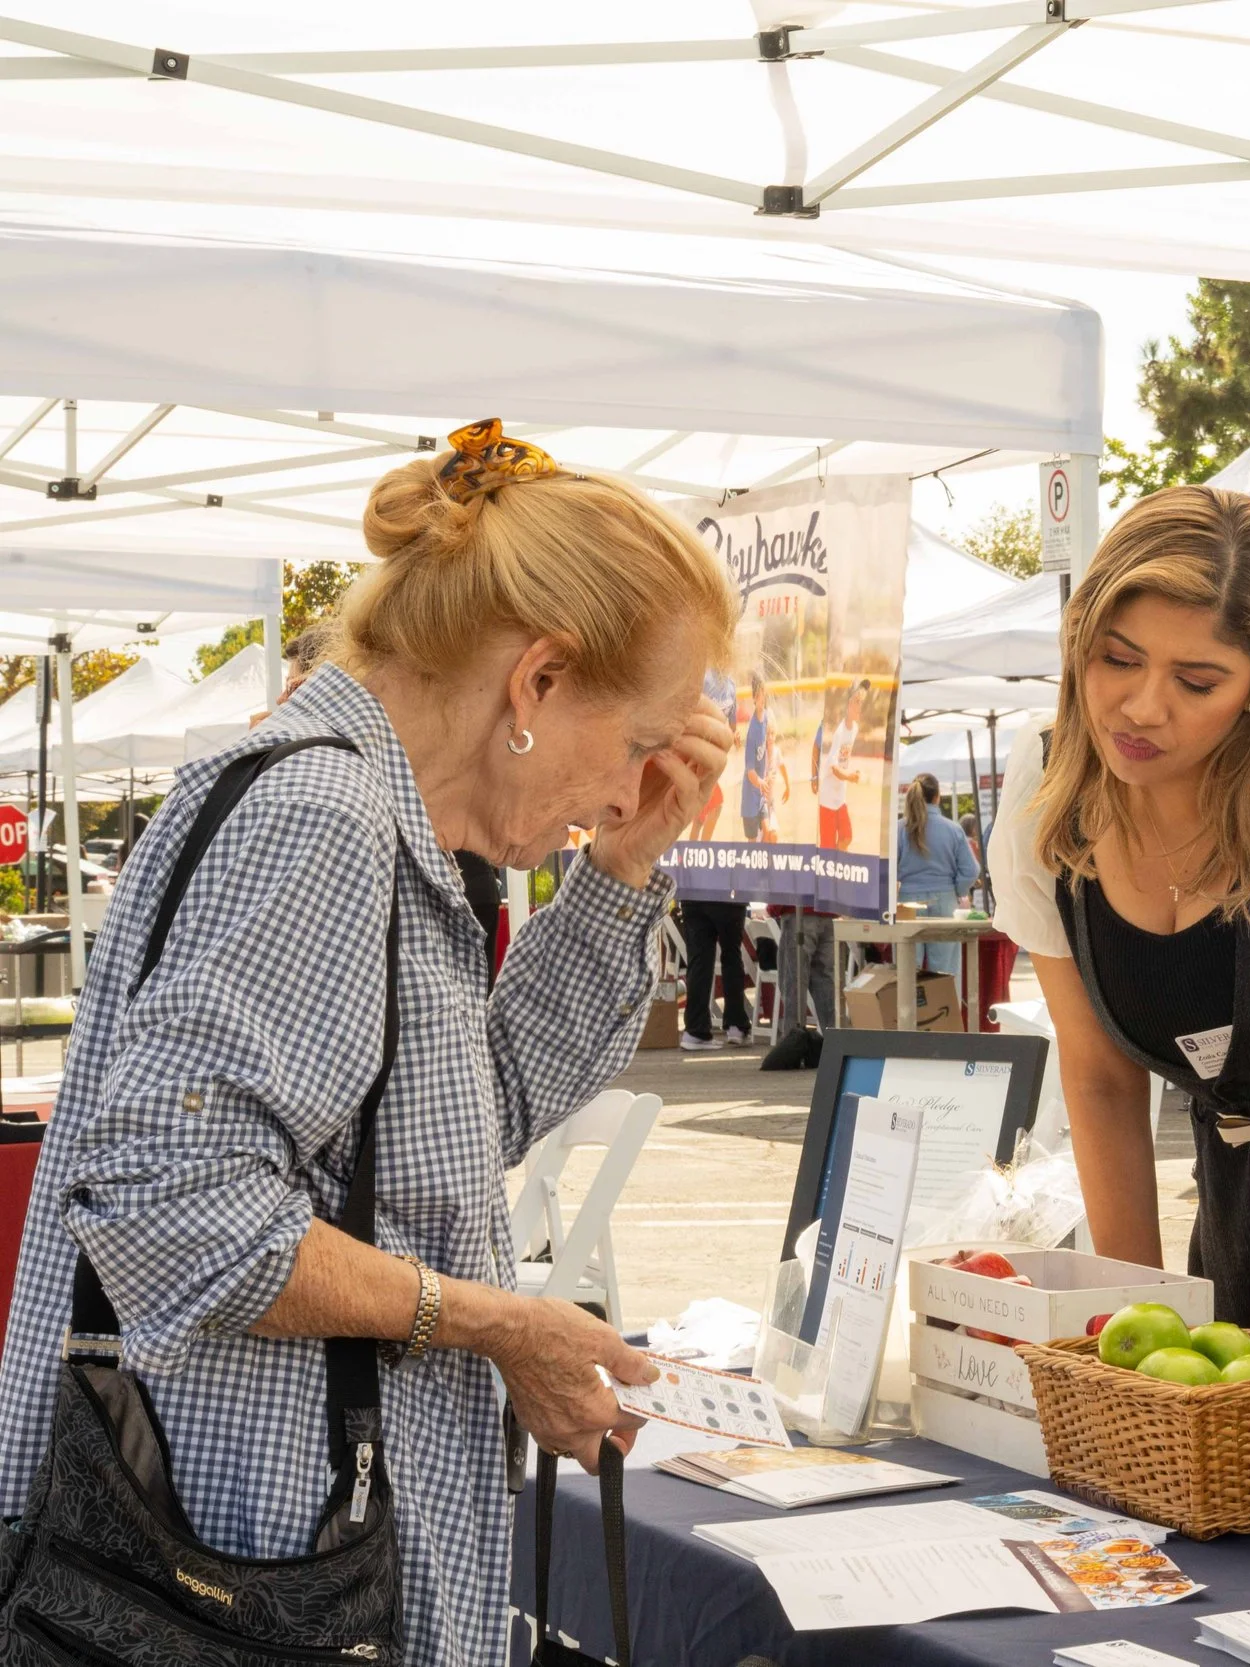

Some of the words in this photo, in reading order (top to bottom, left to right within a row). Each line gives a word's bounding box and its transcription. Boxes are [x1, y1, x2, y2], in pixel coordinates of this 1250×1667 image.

[0, 822, 27, 846] OP
[683, 847, 714, 870] (310)
[1197, 1032, 1231, 1047] SILVER
[927, 1284, 946, 1302] ALL
[951, 1289, 975, 1309] YOU
[979, 1297, 1009, 1318] NEED
[1014, 1306, 1025, 1322] IS
[176, 1567, 233, 1607] baggallini
